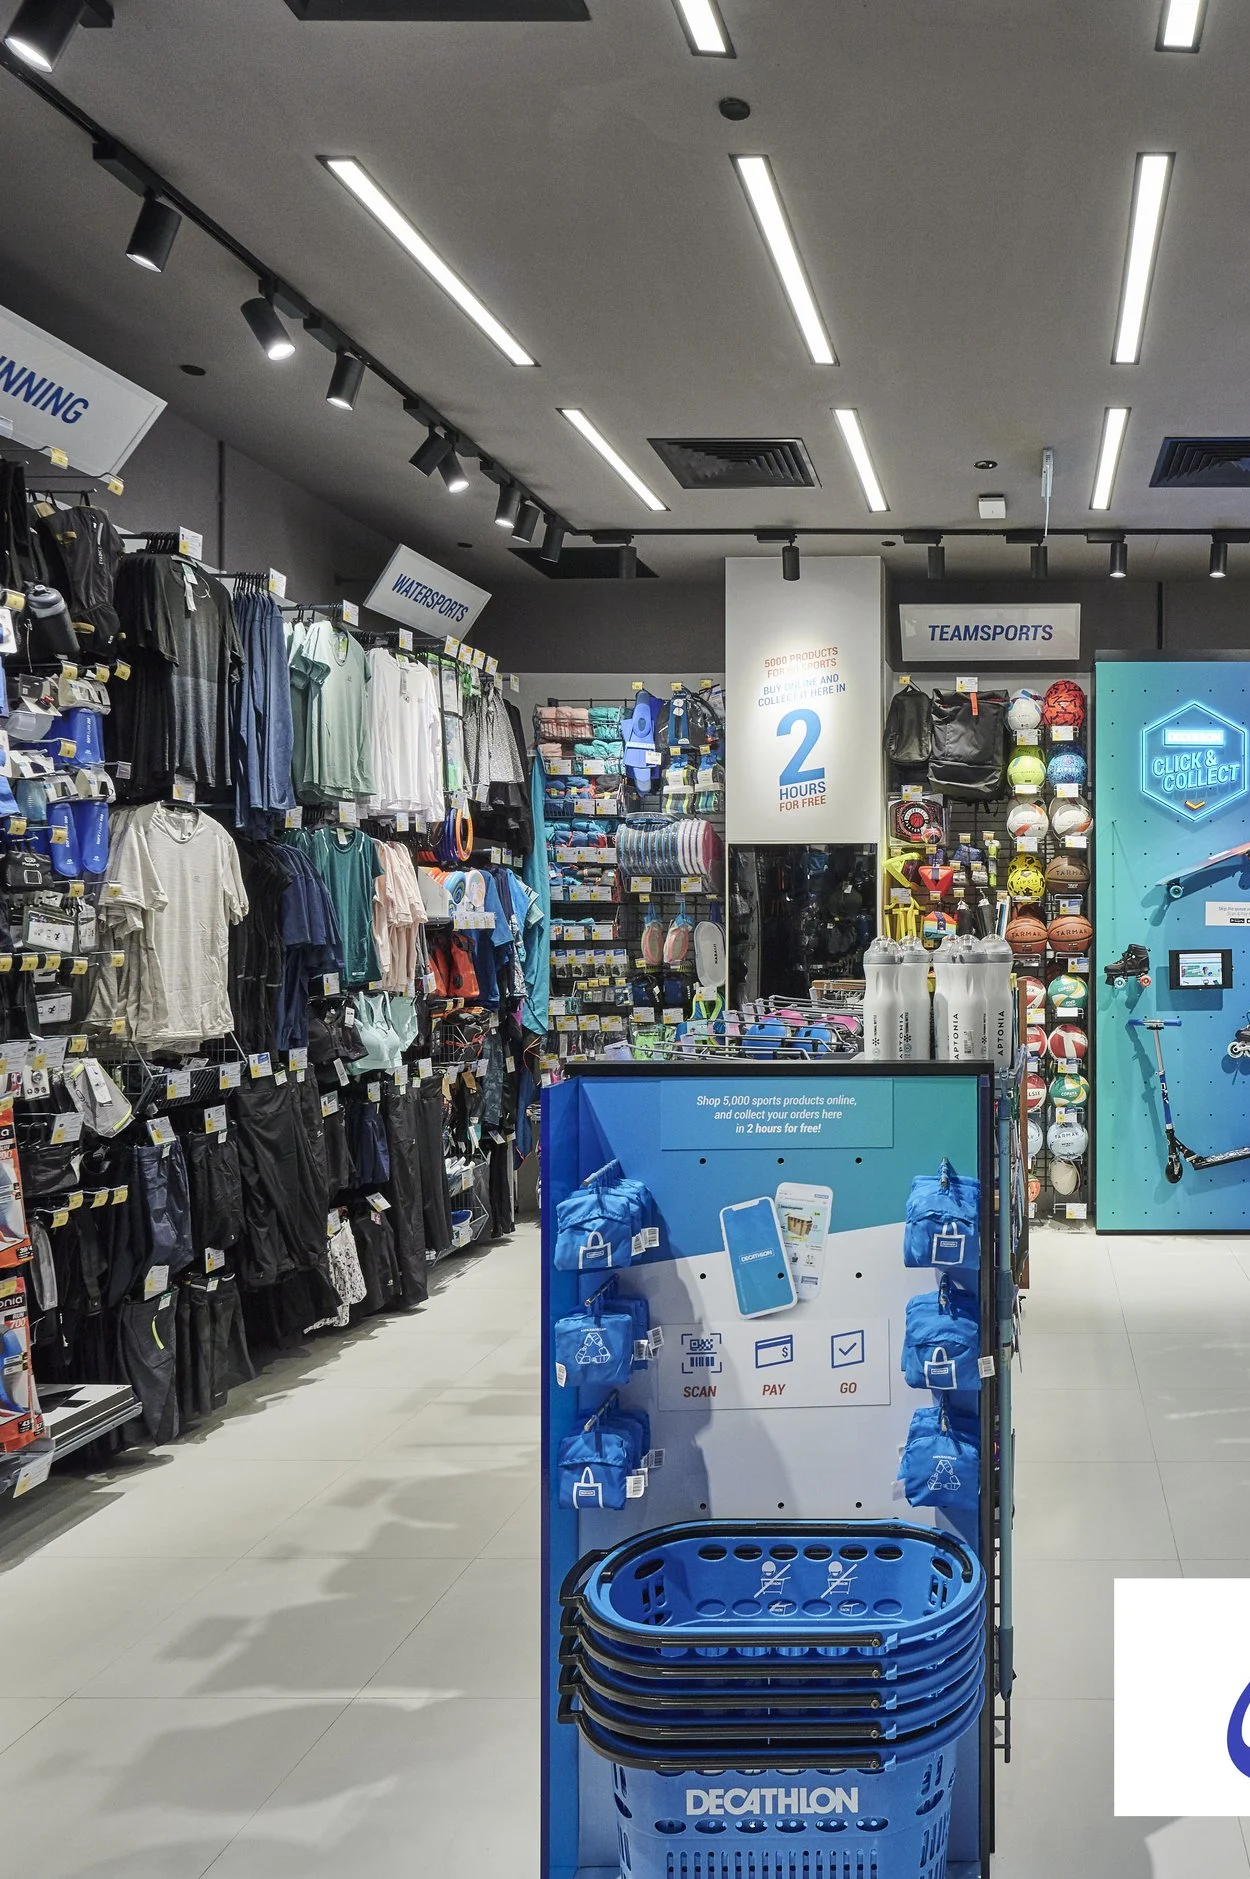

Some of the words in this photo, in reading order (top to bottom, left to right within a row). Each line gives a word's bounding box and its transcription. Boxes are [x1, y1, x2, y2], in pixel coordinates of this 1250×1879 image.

[391, 573, 469, 622] WATERSPORTS
[928, 624, 1053, 641] TEAMSPORTS
[764, 656, 788, 669] 5000
[789, 646, 839, 663] PRODUCTS
[767, 667, 785, 679] FOR
[802, 657, 837, 671] SPORTS
[763, 682, 782, 696] BUY
[784, 678, 818, 693] ONLINE
[820, 673, 839, 685] AND
[758, 693, 797, 708] COLLECT
[811, 685, 834, 698] HERE
[836, 683, 846, 694] IN
[776, 708, 826, 787] 2
[1153, 752, 1203, 776] CLICK
[1205, 749, 1218, 767] &
[1163, 763, 1240, 793] COLLECT
[779, 781, 827, 801] HOURS
[779, 797, 800, 812] FOR
[801, 795, 827, 809] FREE
[697, 1095, 721, 1107] Shop
[723, 1095, 750, 1106] 5,000
[752, 1096, 782, 1107] sports
[783, 1094, 825, 1107] products
[826, 1094, 857, 1107] online,
[1028, 1090, 1041, 1098] LSIX
[714, 1109, 732, 1120] and
[734, 1109, 765, 1120] collect
[767, 1110, 788, 1122] your
[790, 1109, 820, 1119] orders
[821, 1109, 842, 1119] here
[736, 1123, 745, 1134] in
[746, 1123, 754, 1134] 2
[755, 1123, 782, 1134] hours
[784, 1123, 798, 1134] for
[799, 1123, 821, 1134] free!
[0, 1150, 12, 1160] 00
[740, 1250, 773, 1263] DECATHLON
[10, 1318, 26, 1329] 700
[683, 1385, 717, 1398] SCAN
[762, 1384, 786, 1396] PAY
[840, 1382, 857, 1394] GO
[686, 1787, 858, 1815] DECATHLON
